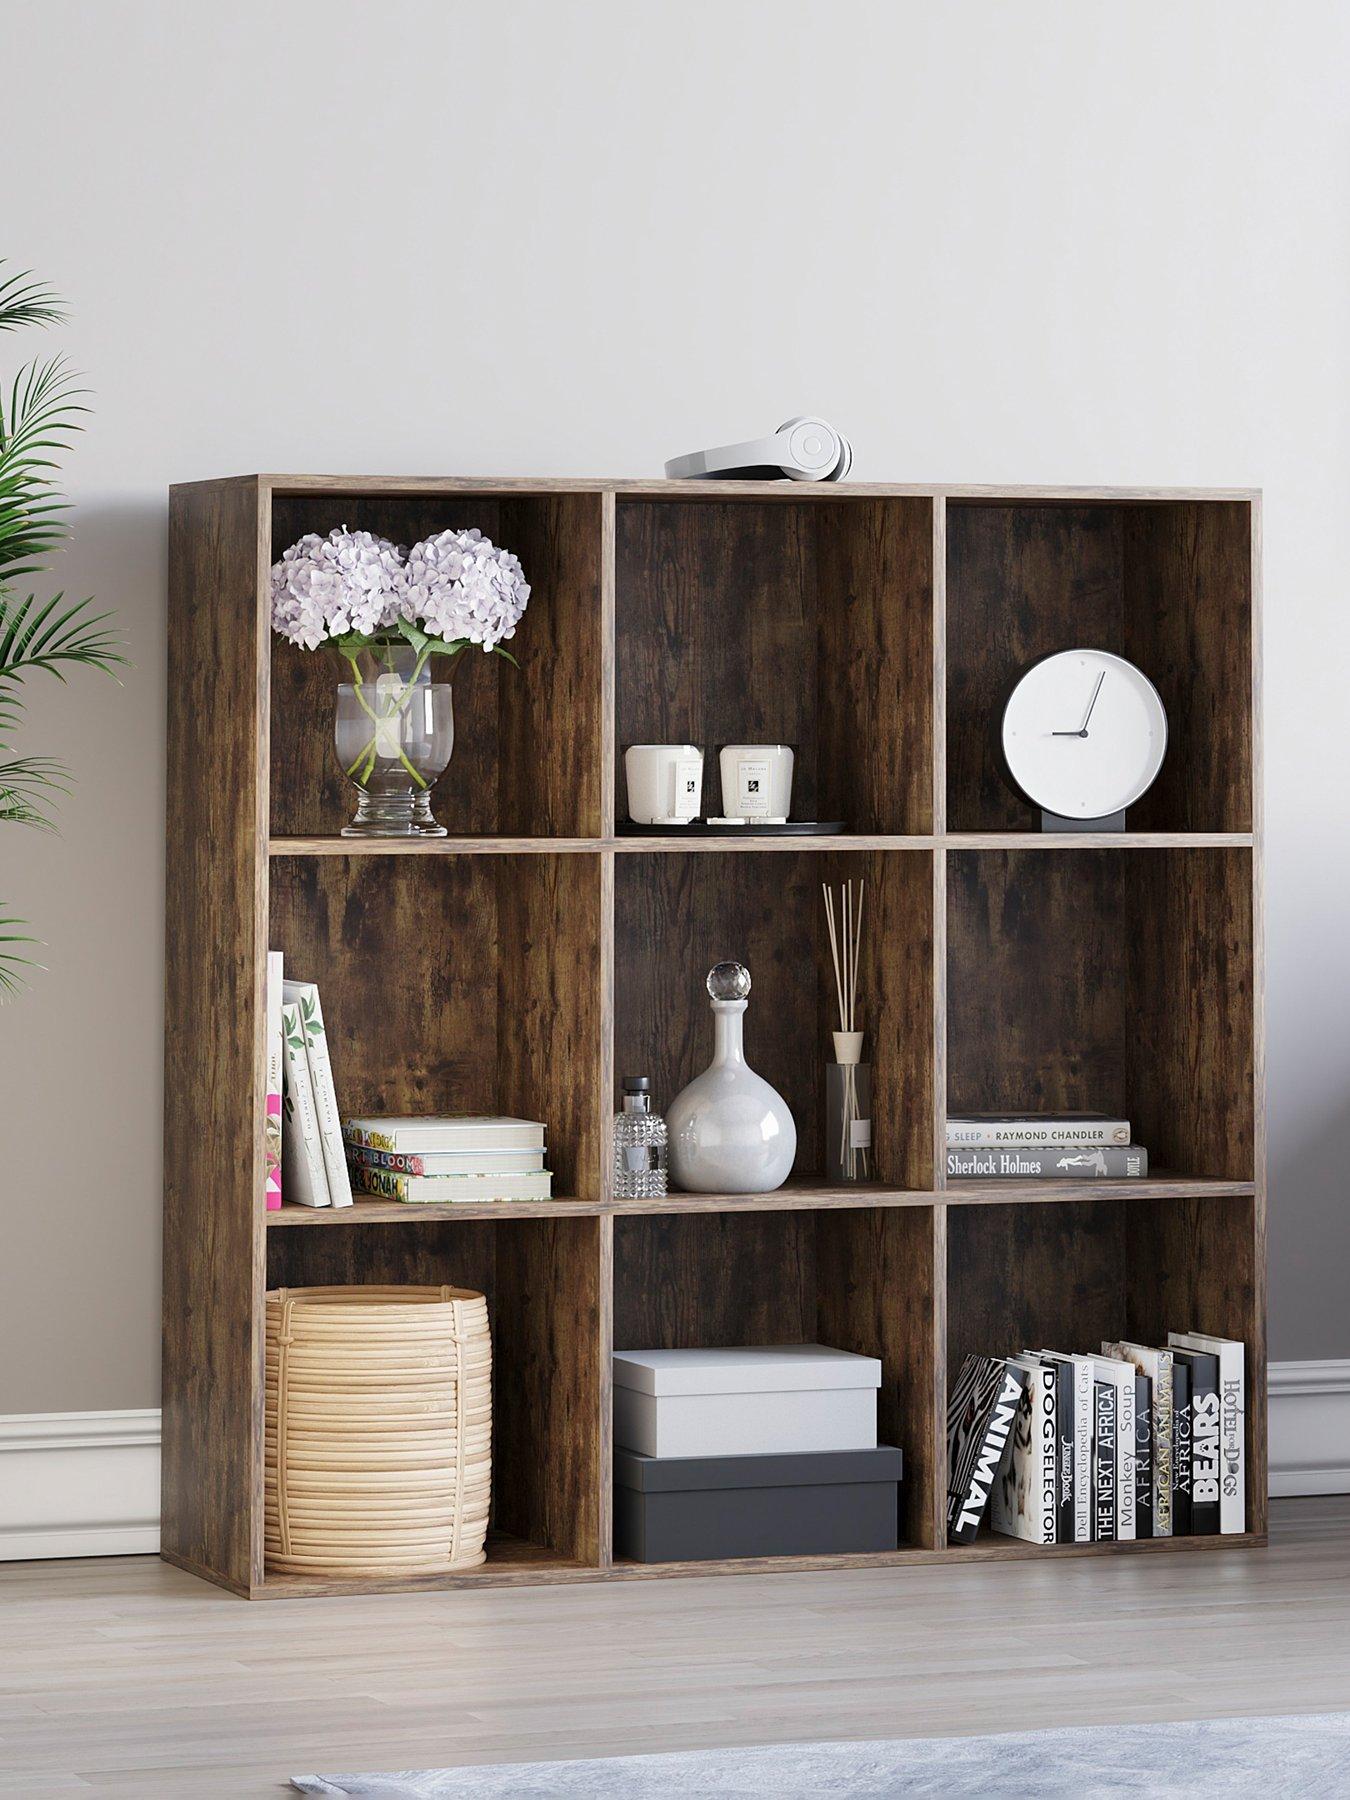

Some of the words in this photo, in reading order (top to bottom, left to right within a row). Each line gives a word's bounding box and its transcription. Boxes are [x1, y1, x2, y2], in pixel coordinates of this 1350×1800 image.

[947, 1154, 996, 1175] Sherlock
[1000, 1154, 1041, 1174] Holmes
[955, 1132, 982, 1141] SLEEP
[996, 1131, 1047, 1140] RAYMOND
[1051, 1130, 1104, 1140] CHANDLER
[1042, 1370, 1055, 1439] DOG
[1079, 1364, 1089, 1394] Cats
[1079, 1397, 1088, 1411] of
[1120, 1385, 1135, 1432] Soup
[1157, 1353, 1171, 1441] ANIMALS
[1223, 1379, 1240, 1436] HOTEL
[1098, 1388, 1114, 1449] AFRICA
[1179, 1403, 1191, 1495] AFRICA
[1192, 1392, 1220, 1503] BEARS
[955, 1373, 1023, 1533] ANIMAL
[1077, 1417, 1089, 1504] Encyclopedia
[1098, 1457, 1113, 1501] NEXT
[1136, 1408, 1151, 1507] AFRICA
[1172, 1472, 1180, 1491] New
[1042, 1443, 1055, 1544] SELECTOR
[1120, 1451, 1136, 1527] Monkey
[1156, 1447, 1170, 1532] AFRICAN
[1077, 1511, 1087, 1537] Dell
[1098, 1506, 1113, 1539] THE
